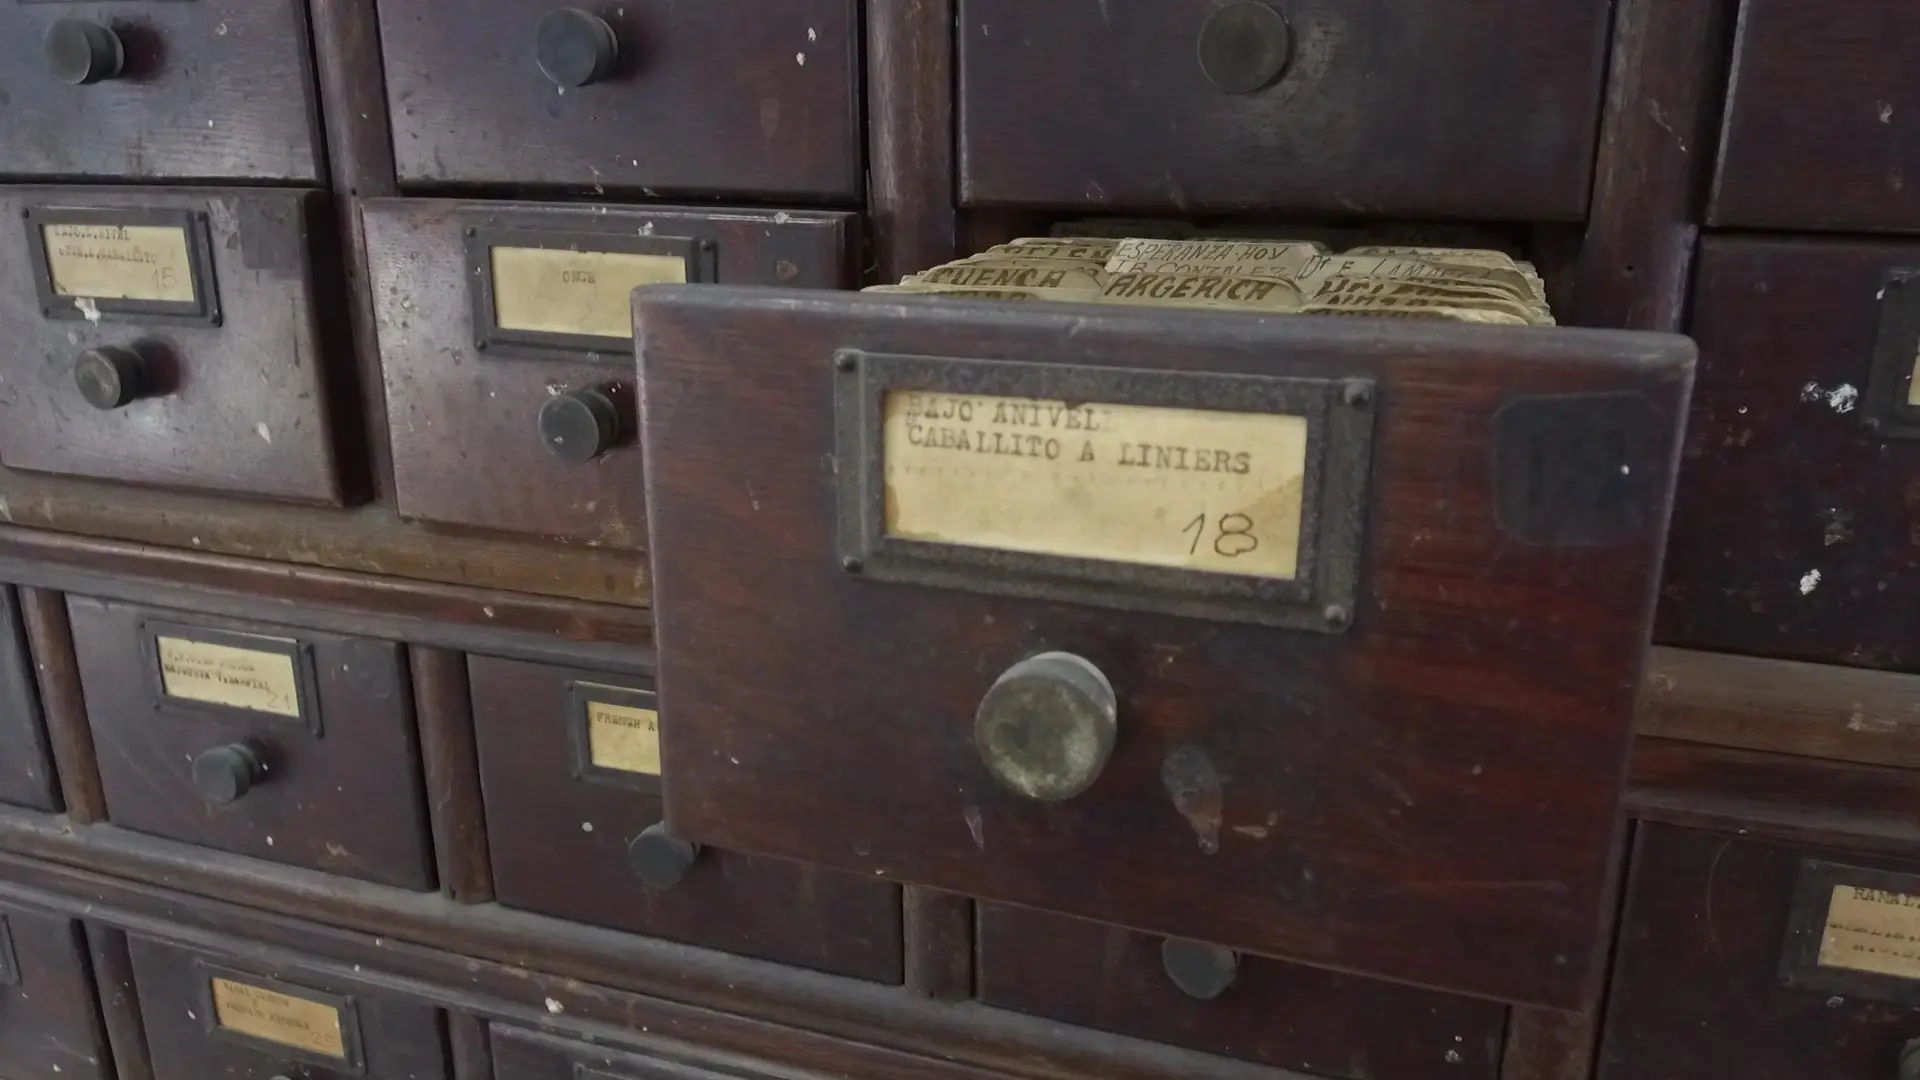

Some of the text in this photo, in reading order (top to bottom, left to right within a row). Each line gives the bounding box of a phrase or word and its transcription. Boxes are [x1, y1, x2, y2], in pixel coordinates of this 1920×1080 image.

[151, 267, 178, 292] 15
[922, 266, 1067, 288] CUENCA
[1104, 274, 1276, 300] ARGERICH
[907, 424, 1252, 475] CABALLITO A LINIERS
[1181, 512, 1259, 558] 18
[265, 691, 292, 711] 21
[596, 711, 641, 729] FRENCH
